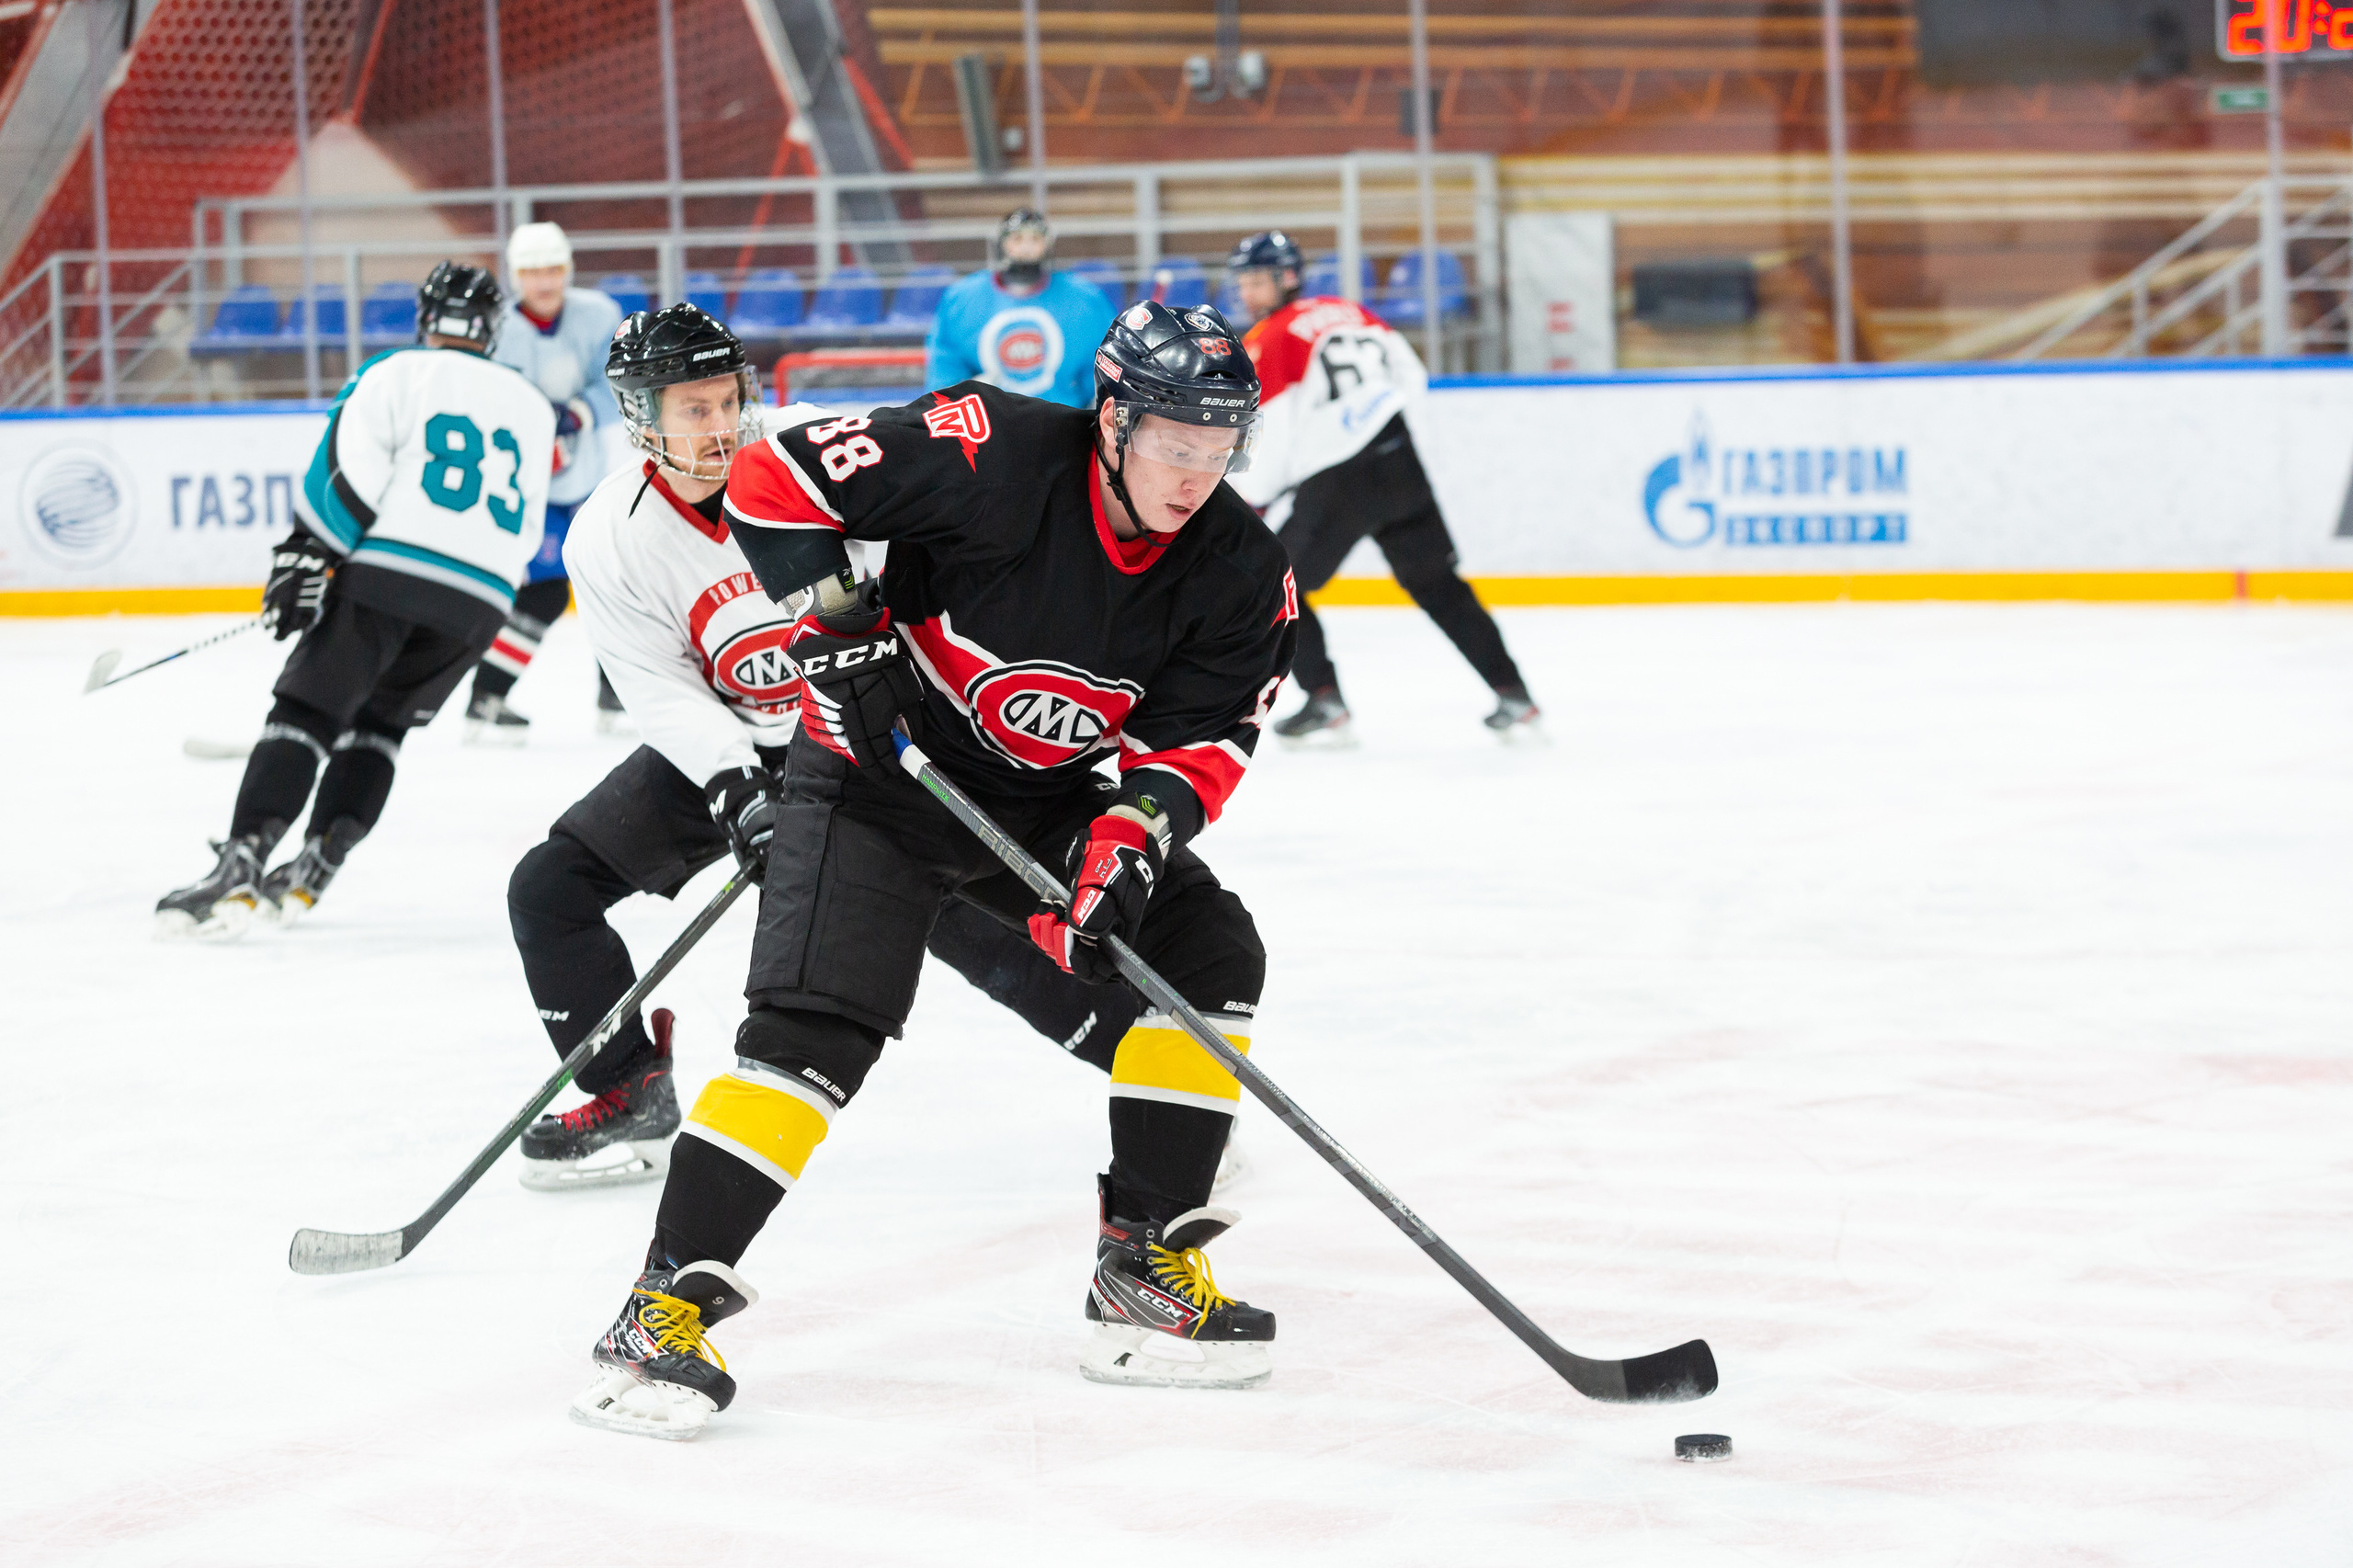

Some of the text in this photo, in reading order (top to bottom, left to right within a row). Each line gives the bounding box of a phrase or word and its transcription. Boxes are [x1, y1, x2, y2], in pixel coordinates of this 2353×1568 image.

[2226, 0, 2353, 55] 20:
[692, 347, 731, 362] BAUER
[1198, 336, 1232, 356] 88
[1199, 397, 1245, 408] BAUER
[806, 416, 884, 483] 88
[421, 413, 525, 536] 83
[1722, 448, 1906, 494] ГАЗПРОМ
[170, 474, 294, 528] ГАЗП
[708, 572, 763, 606] POWE
[802, 638, 898, 676] CCM
[1076, 889, 1097, 921] CCM
[801, 1066, 847, 1102] BAUER
[1136, 1287, 1188, 1319] CCM
